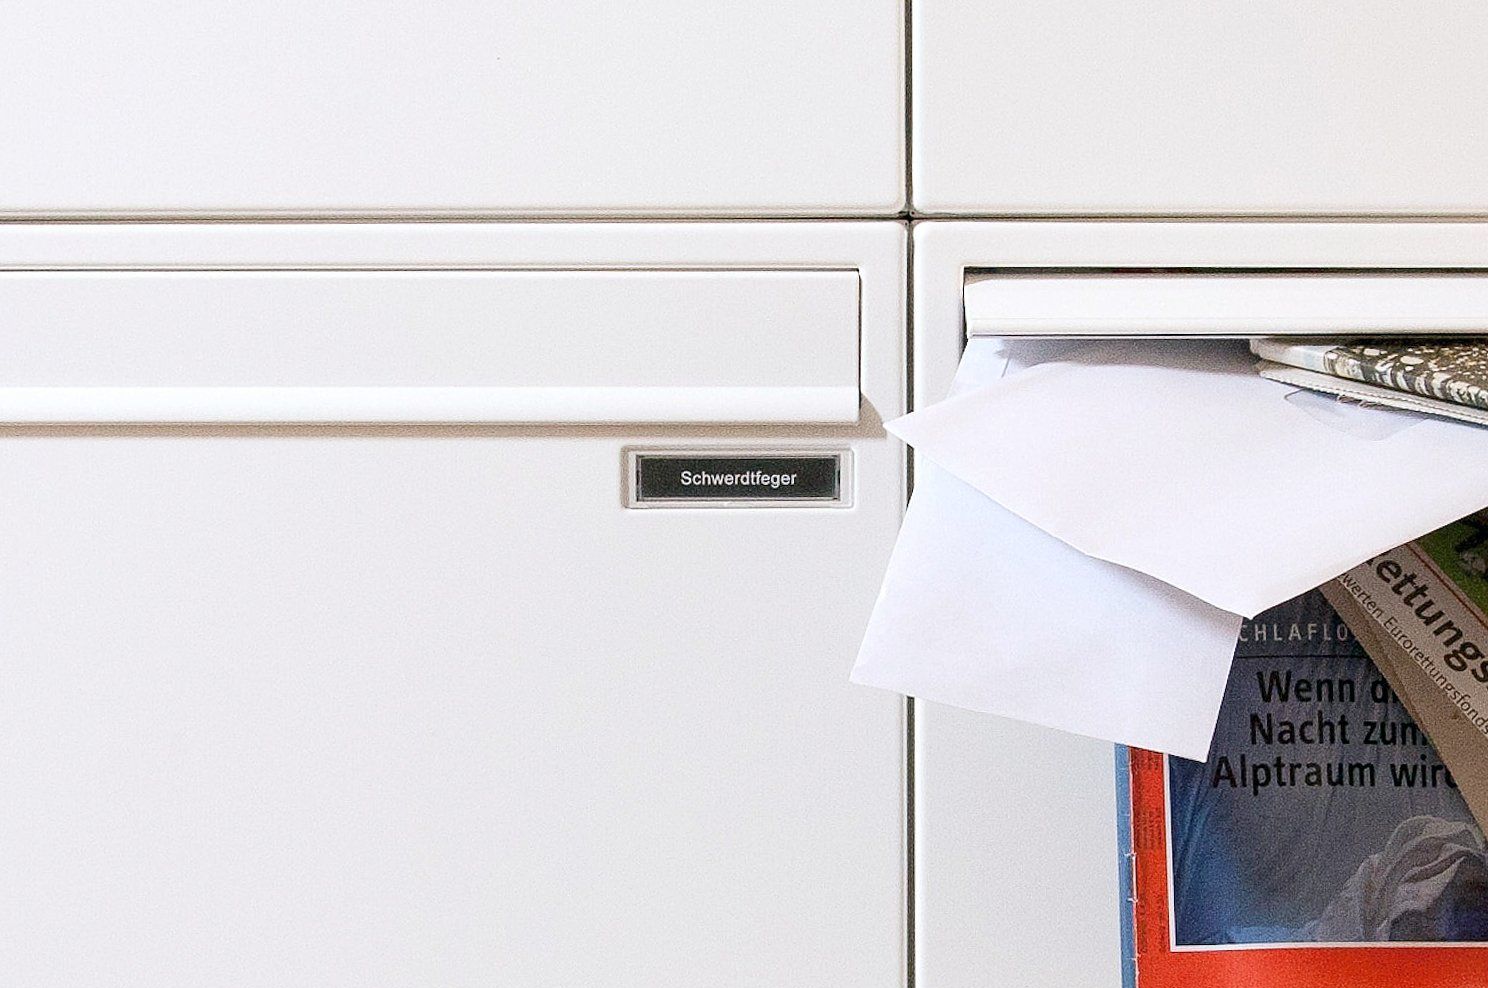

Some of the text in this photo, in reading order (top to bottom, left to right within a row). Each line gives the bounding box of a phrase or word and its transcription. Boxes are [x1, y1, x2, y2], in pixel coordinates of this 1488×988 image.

[680, 470, 798, 489] Schwerdtfeger
[1238, 622, 1349, 643] CHLAFLO
[1256, 670, 1355, 703] Wenn
[1250, 710, 1351, 746] Nacht
[1212, 753, 1376, 796] Alptraum
